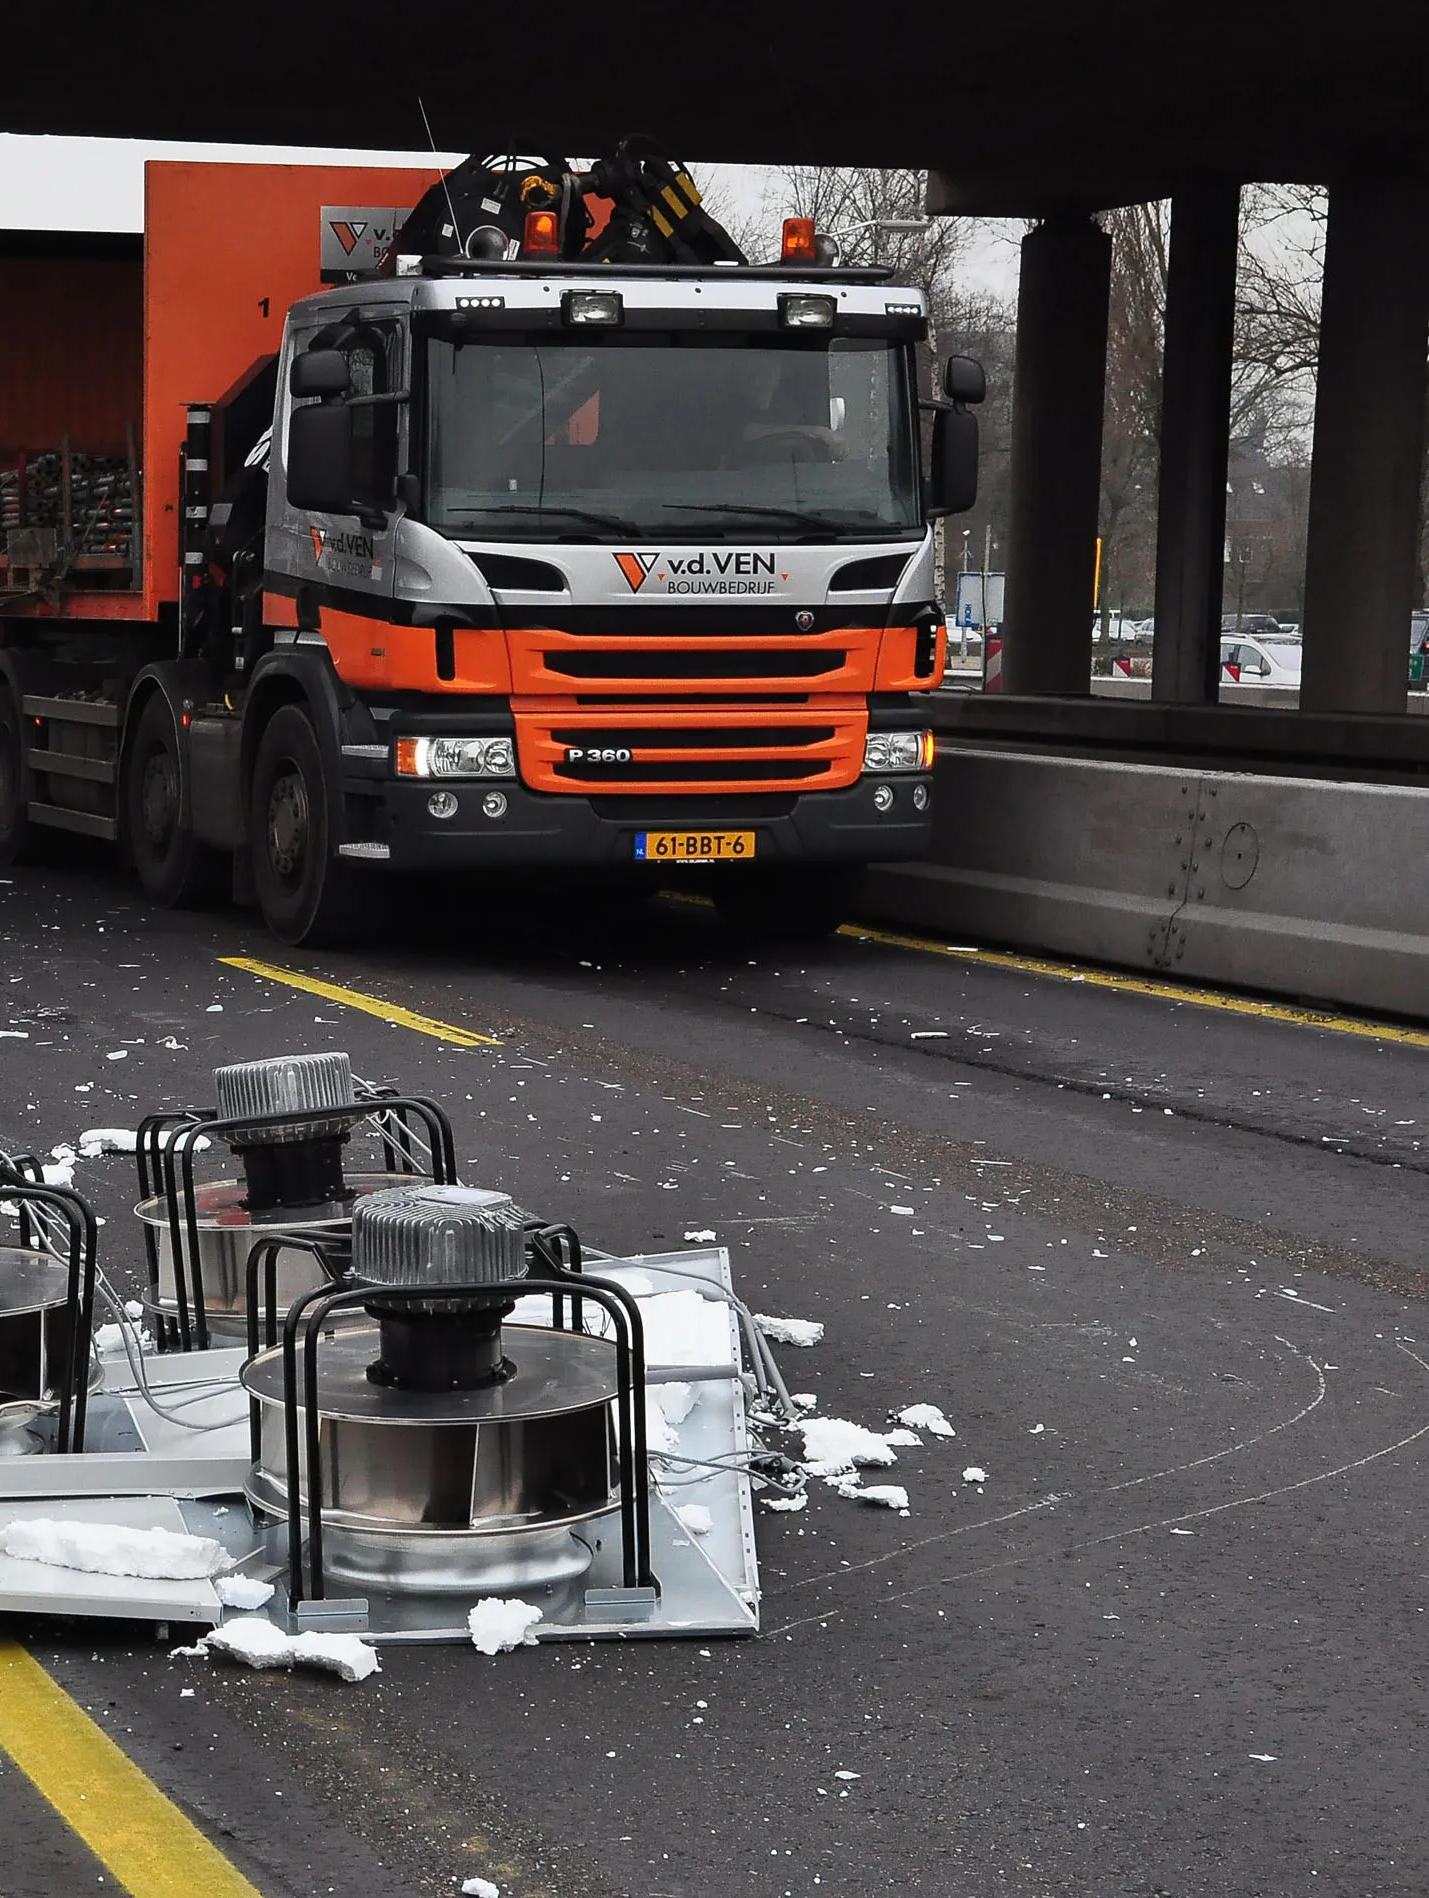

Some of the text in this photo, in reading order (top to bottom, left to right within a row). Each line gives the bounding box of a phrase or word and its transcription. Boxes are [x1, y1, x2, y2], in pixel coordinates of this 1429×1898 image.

[258, 297, 270, 318] 1
[667, 580, 775, 595] BOUWBEDRIJF
[569, 748, 630, 762] P 360
[655, 835, 745, 856] 61-BBT-6
